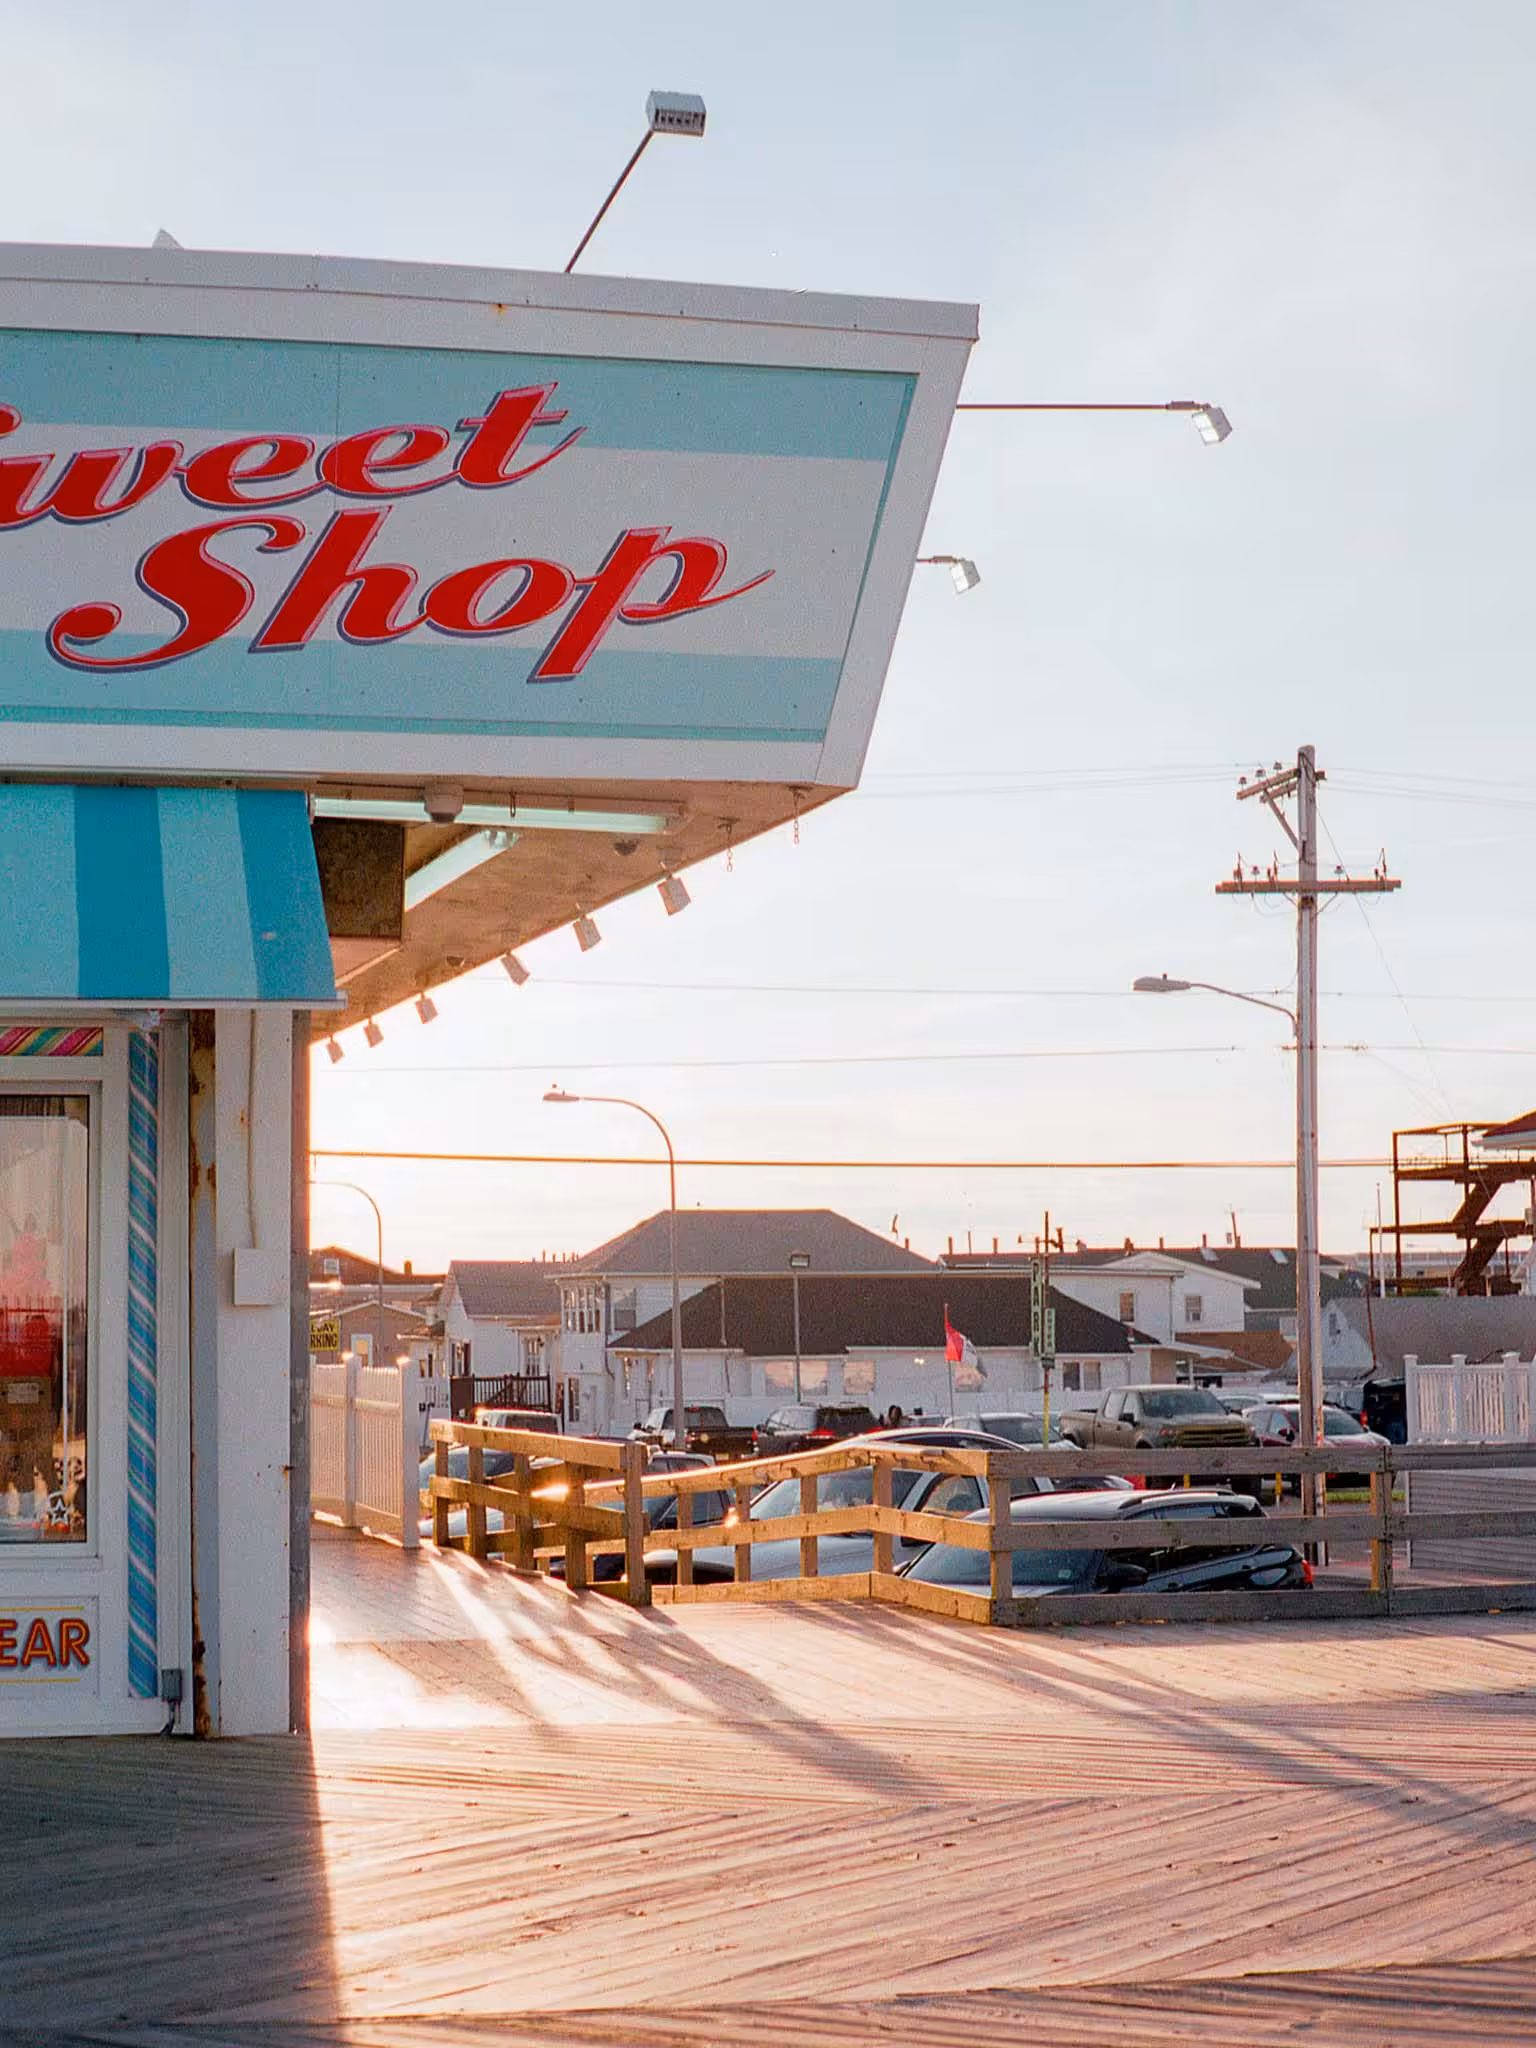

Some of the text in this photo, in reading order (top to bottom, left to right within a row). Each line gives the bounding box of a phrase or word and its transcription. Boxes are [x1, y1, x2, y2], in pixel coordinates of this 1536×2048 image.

[0, 382, 588, 530] weet
[46, 504, 776, 685] Shop
[0, 1618, 90, 1667] EAR
